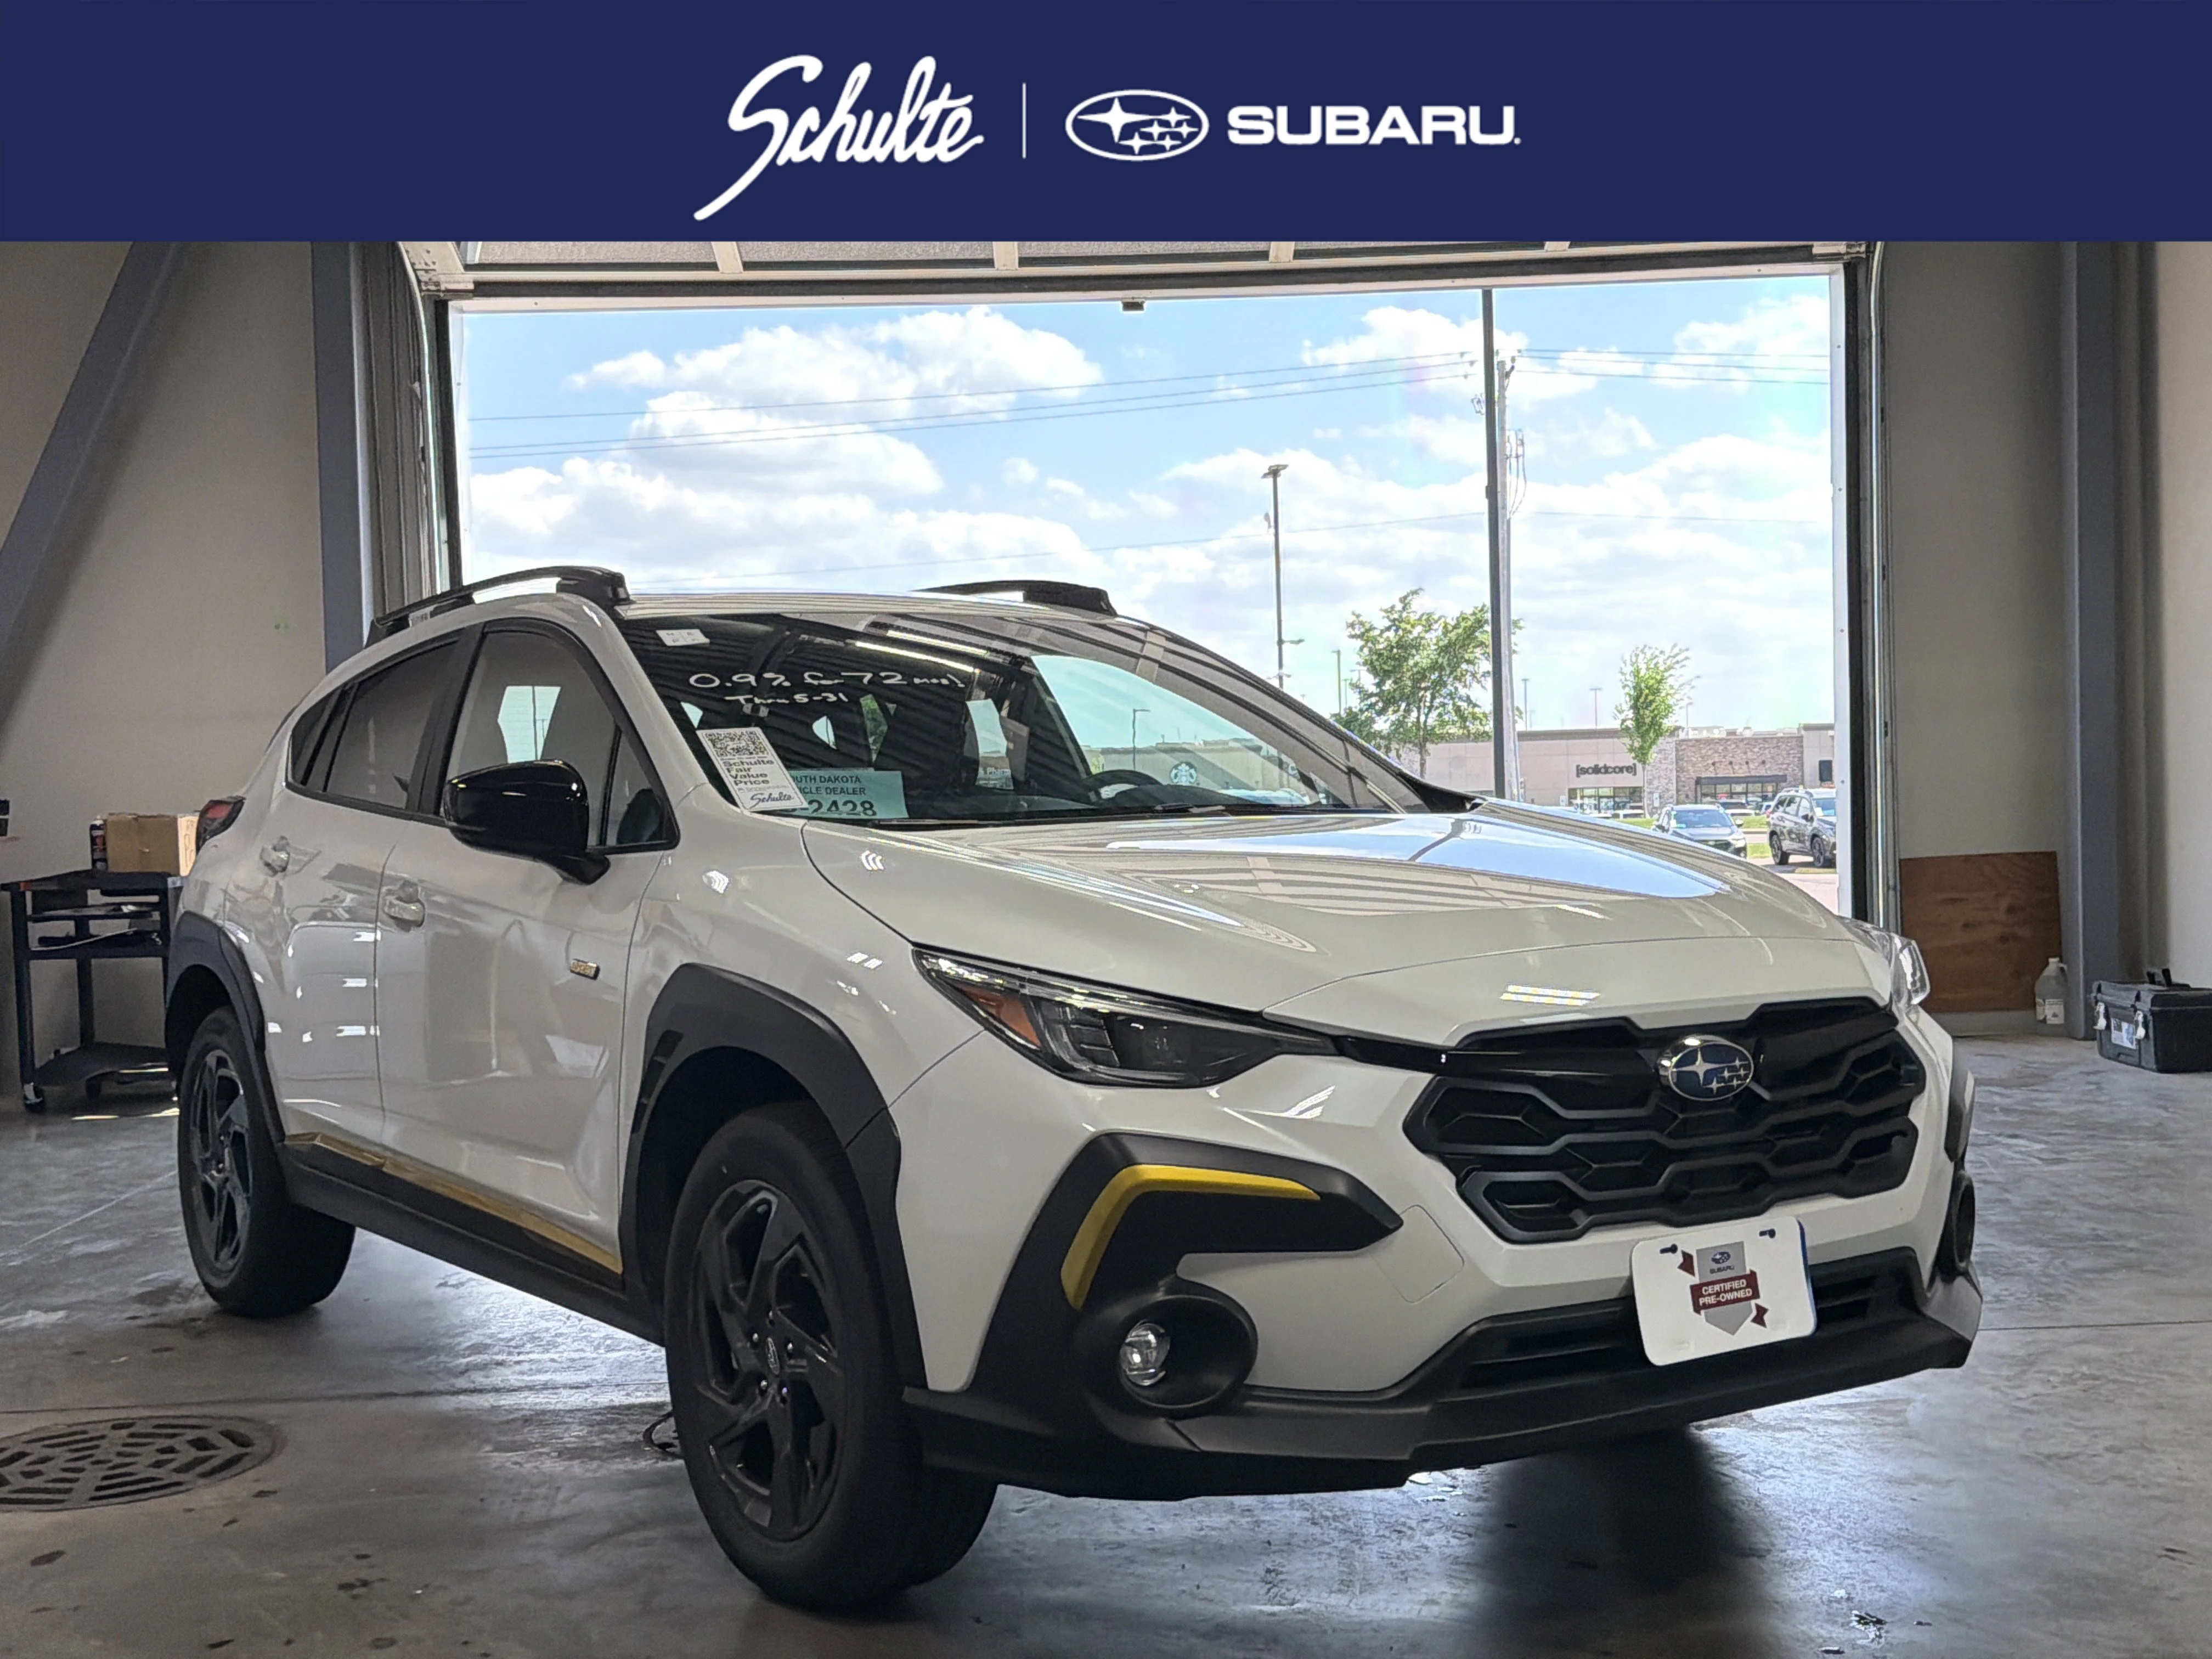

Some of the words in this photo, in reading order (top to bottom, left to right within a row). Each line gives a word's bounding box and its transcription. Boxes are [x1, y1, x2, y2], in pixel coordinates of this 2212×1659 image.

[840, 672, 907, 685] 72
[794, 693, 848, 703] 5-31
[819, 775, 862, 784] DAKOTA
[825, 787, 866, 795] DEALER
[749, 792, 794, 810] Schulte
[1702, 1279, 1747, 1295] CERTIFIED
[1699, 1288, 1753, 1306] PRE-OWNED
